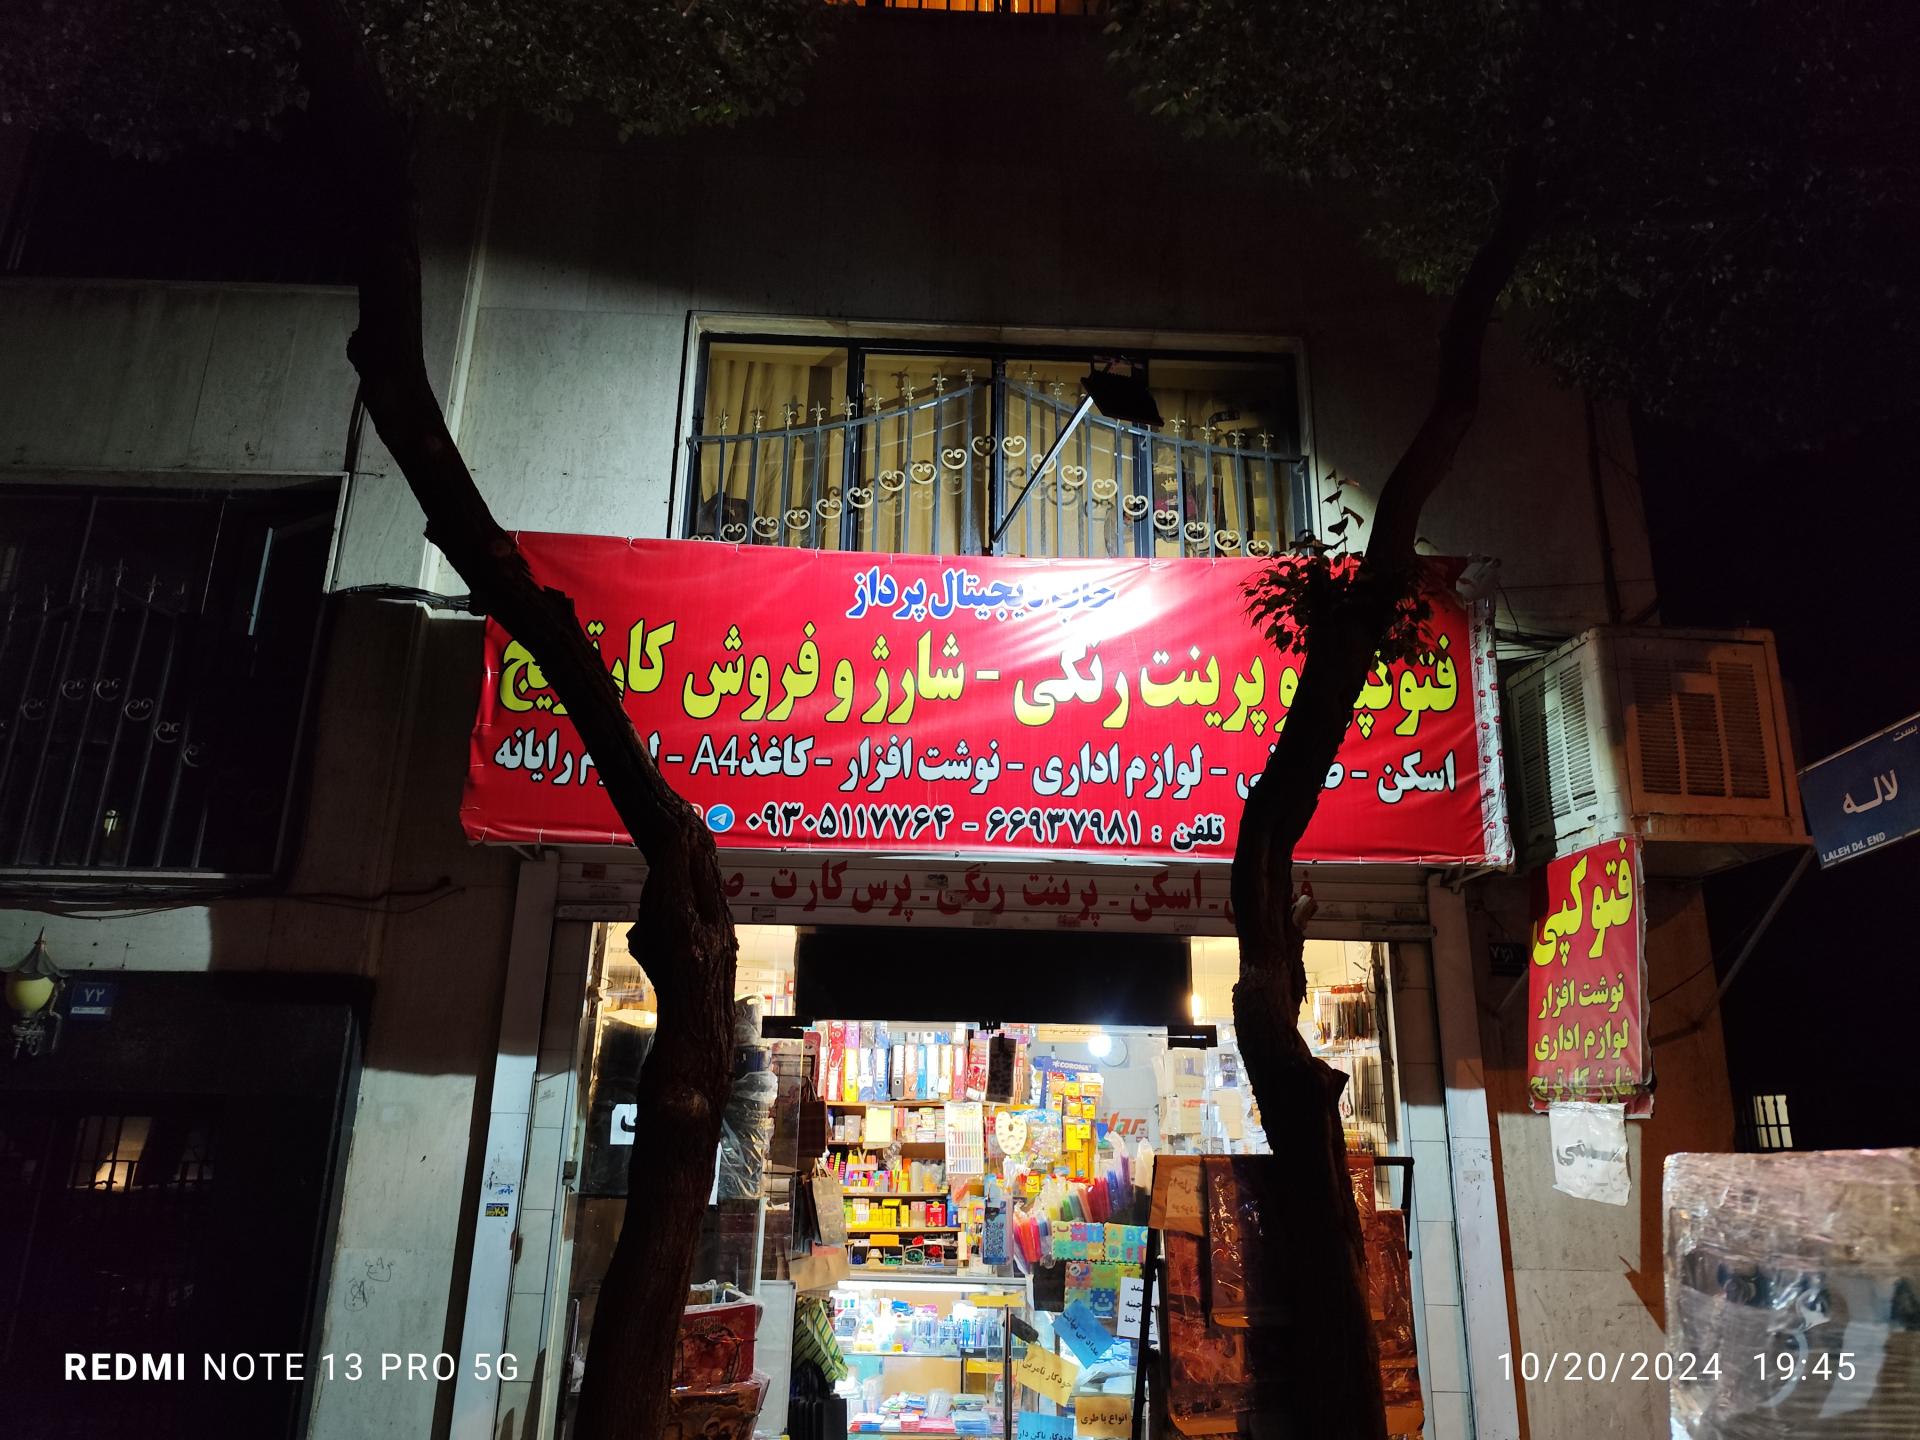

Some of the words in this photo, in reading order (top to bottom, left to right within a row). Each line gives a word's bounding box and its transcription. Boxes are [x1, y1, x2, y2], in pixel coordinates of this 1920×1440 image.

[845, 565, 925, 619] پرداز
[681, 621, 821, 722] فروش
[824, 657, 855, 723] و
[860, 632, 966, 724] شارژ
[1013, 640, 1131, 728] رنگی
[1139, 645, 1265, 736] پرینت
[1343, 634, 1458, 738] فتوکپ
[493, 727, 575, 786] رایانه
[839, 735, 913, 793] افزار
[916, 741, 1001, 795] نوشت
[1031, 741, 1120, 798] اداری
[1125, 743, 1203, 798] لوازم
[1376, 749, 1456, 802] اسکن
[1842, 768, 1898, 814] لاله
[745, 800, 954, 840] ۰۹۳۰۵۱۱۷۷۶۴
[984, 807, 1141, 845] ۶۶۹۳۷۹۸۱
[1170, 813, 1226, 853] تلفن
[1822, 844, 1851, 863] LALEH
[1867, 831, 1887, 847] END
[770, 859, 849, 912] کارت
[851, 873, 915, 923] پرس
[936, 862, 1006, 916] رنگی
[1022, 873, 1101, 928] پرینت
[1130, 870, 1201, 921] اسکن
[1531, 838, 1635, 968] فتوکپی
[84, 988, 105, 1002] ۷۲
[1537, 977, 1575, 1020] افزار
[1578, 971, 1626, 1014] نوشت
[1534, 1022, 1581, 1061] اداری
[1584, 1018, 1630, 1060] لوازم
